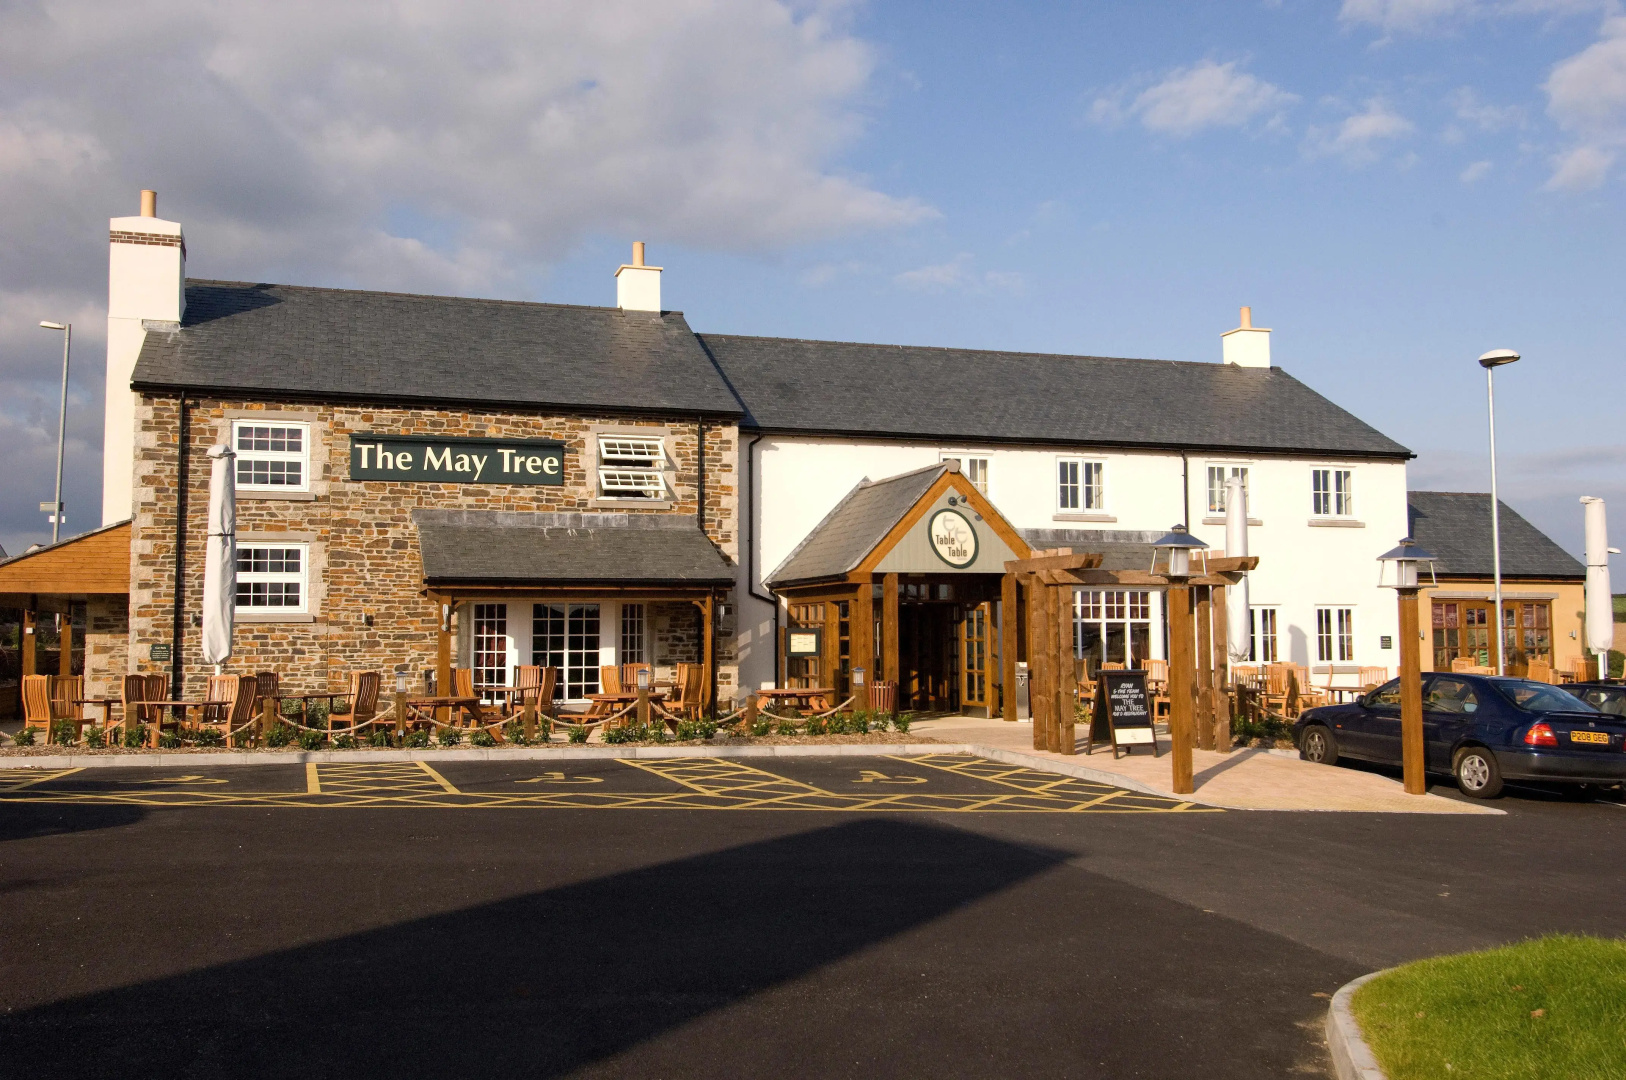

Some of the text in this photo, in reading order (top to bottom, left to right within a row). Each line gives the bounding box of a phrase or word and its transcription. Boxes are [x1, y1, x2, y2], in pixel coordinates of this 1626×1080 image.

[354, 443, 559, 481] The May Tree
[936, 531, 955, 545] Table
[948, 543, 967, 557] Table
[1571, 731, 1591, 741] P208
